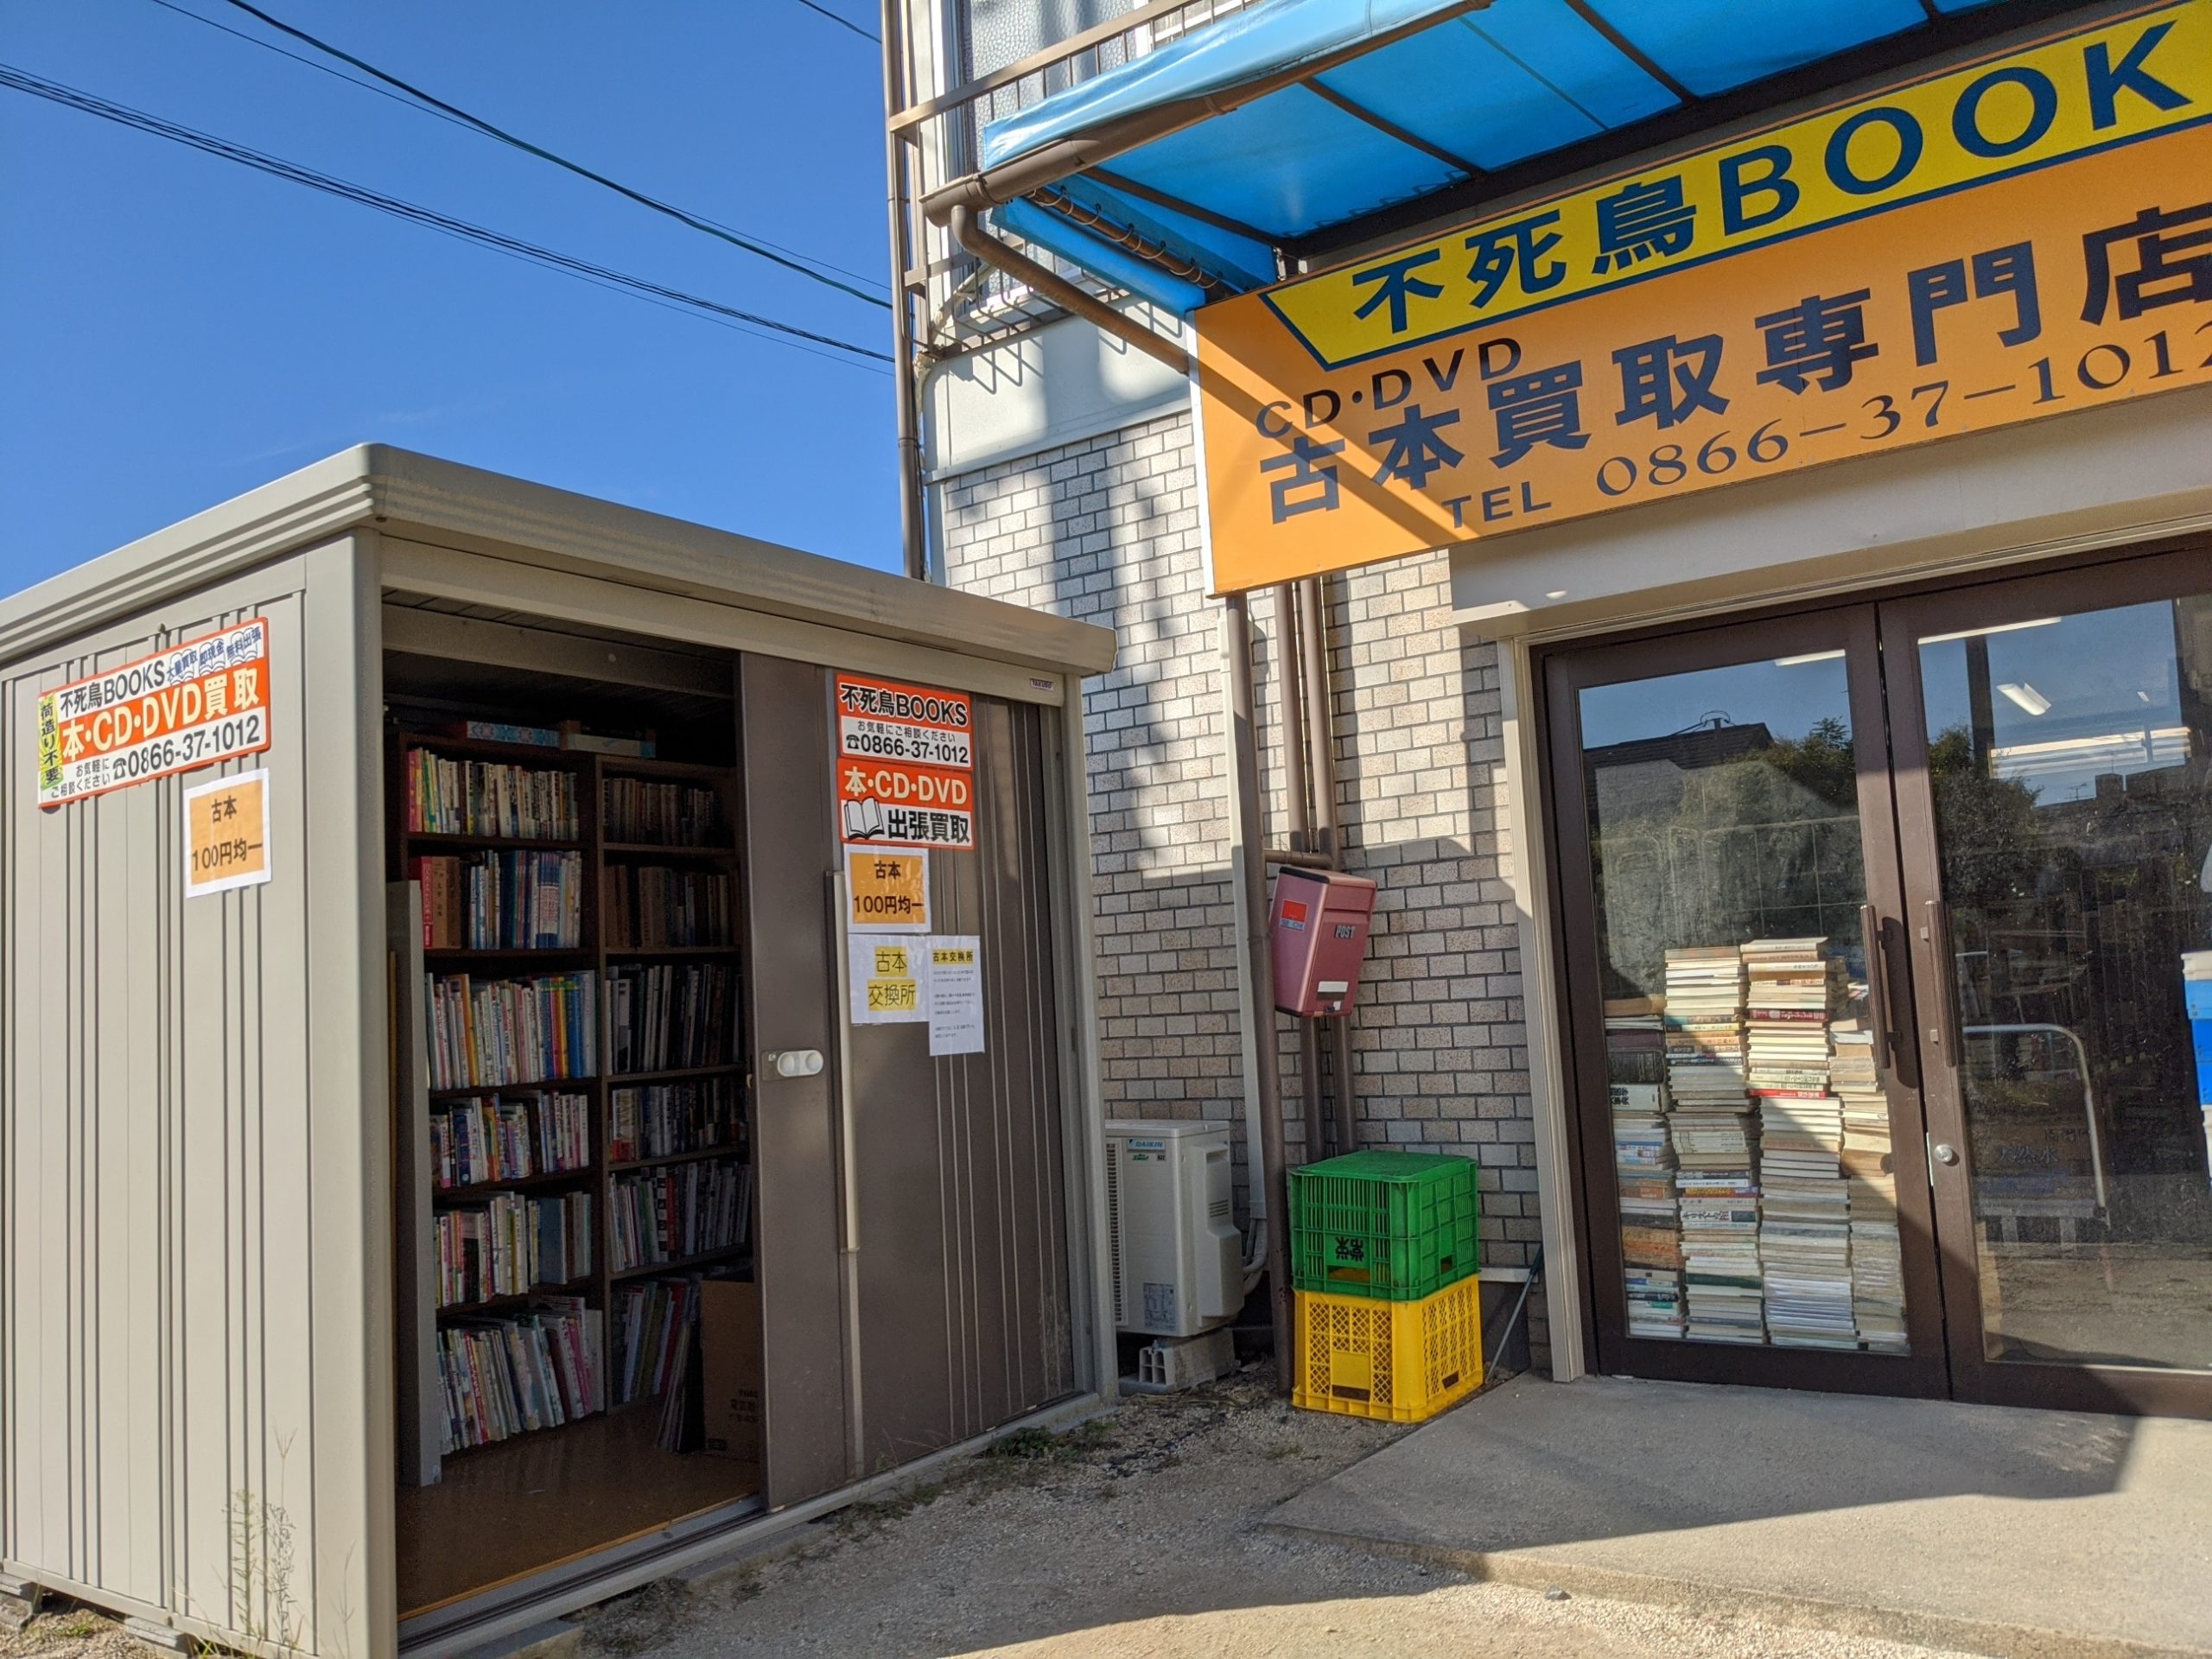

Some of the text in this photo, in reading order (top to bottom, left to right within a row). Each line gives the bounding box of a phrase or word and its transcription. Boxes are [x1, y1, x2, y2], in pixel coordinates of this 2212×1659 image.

[1260, 206, 2212, 524] 古本買取専門店
[1442, 481, 1552, 529] TEL
[60, 660, 166, 718] 不死鳥BOOKS
[226, 626, 262, 659] 無料出張
[840, 683, 968, 727] 不死鳥BOOKS
[40, 701, 60, 783] 荷造り不要
[857, 721, 956, 742] お気軽にご相談ください
[128, 715, 260, 777] 0866-37-1012
[861, 734, 969, 764] 0866-37-1012
[76, 758, 110, 777] お気軽に
[51, 772, 111, 798] ご相談ください
[211, 796, 238, 824] 古本
[888, 809, 970, 843] 出張買取
[192, 840, 263, 872] 100円均一
[874, 861, 901, 880] 古本
[854, 895, 924, 914] 100円均一
[1335, 925, 1356, 939] POST
[875, 951, 907, 973] 古本
[932, 951, 974, 963] 古本交換所
[868, 984, 916, 1007] 交換所
